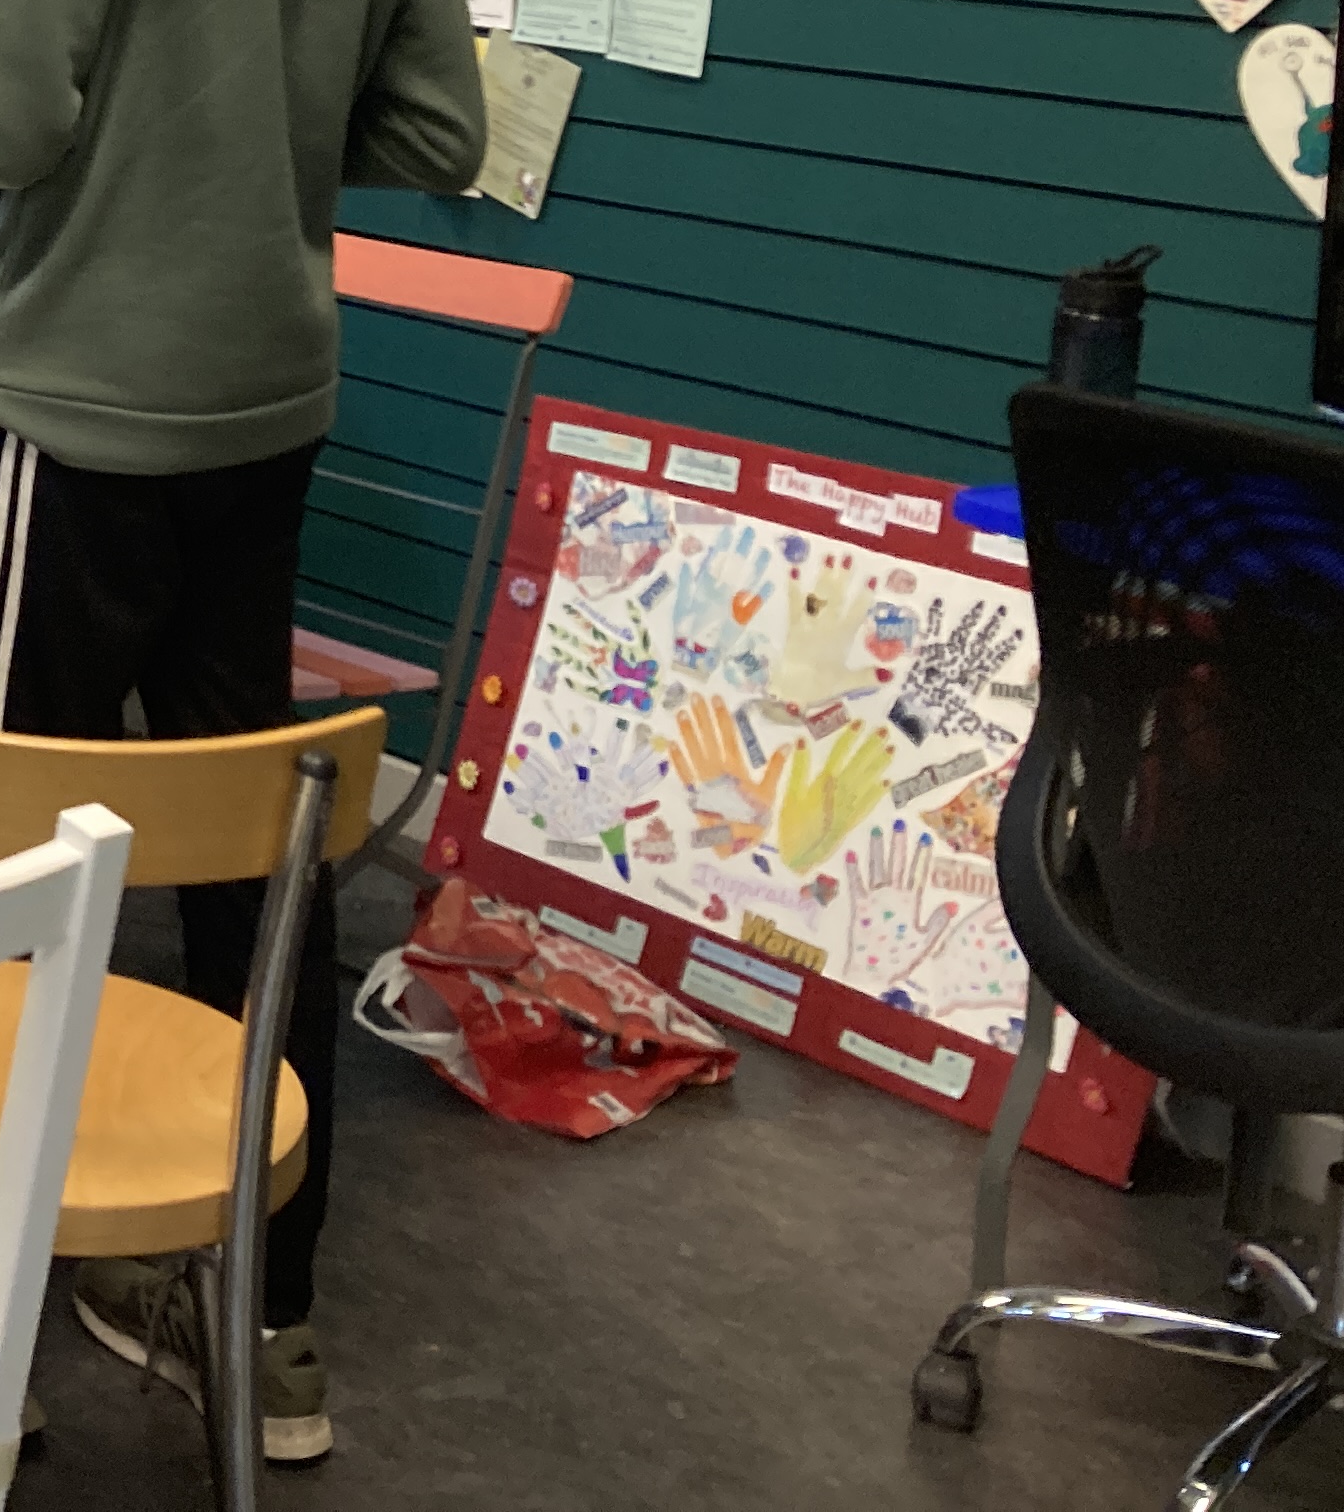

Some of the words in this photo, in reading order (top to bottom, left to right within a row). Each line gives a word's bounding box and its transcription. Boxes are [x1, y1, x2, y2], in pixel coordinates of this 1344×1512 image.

[774, 470, 810, 492] The
[822, 482, 886, 525] Happy
[895, 501, 936, 525] Hub
[741, 910, 828, 974] Warm
